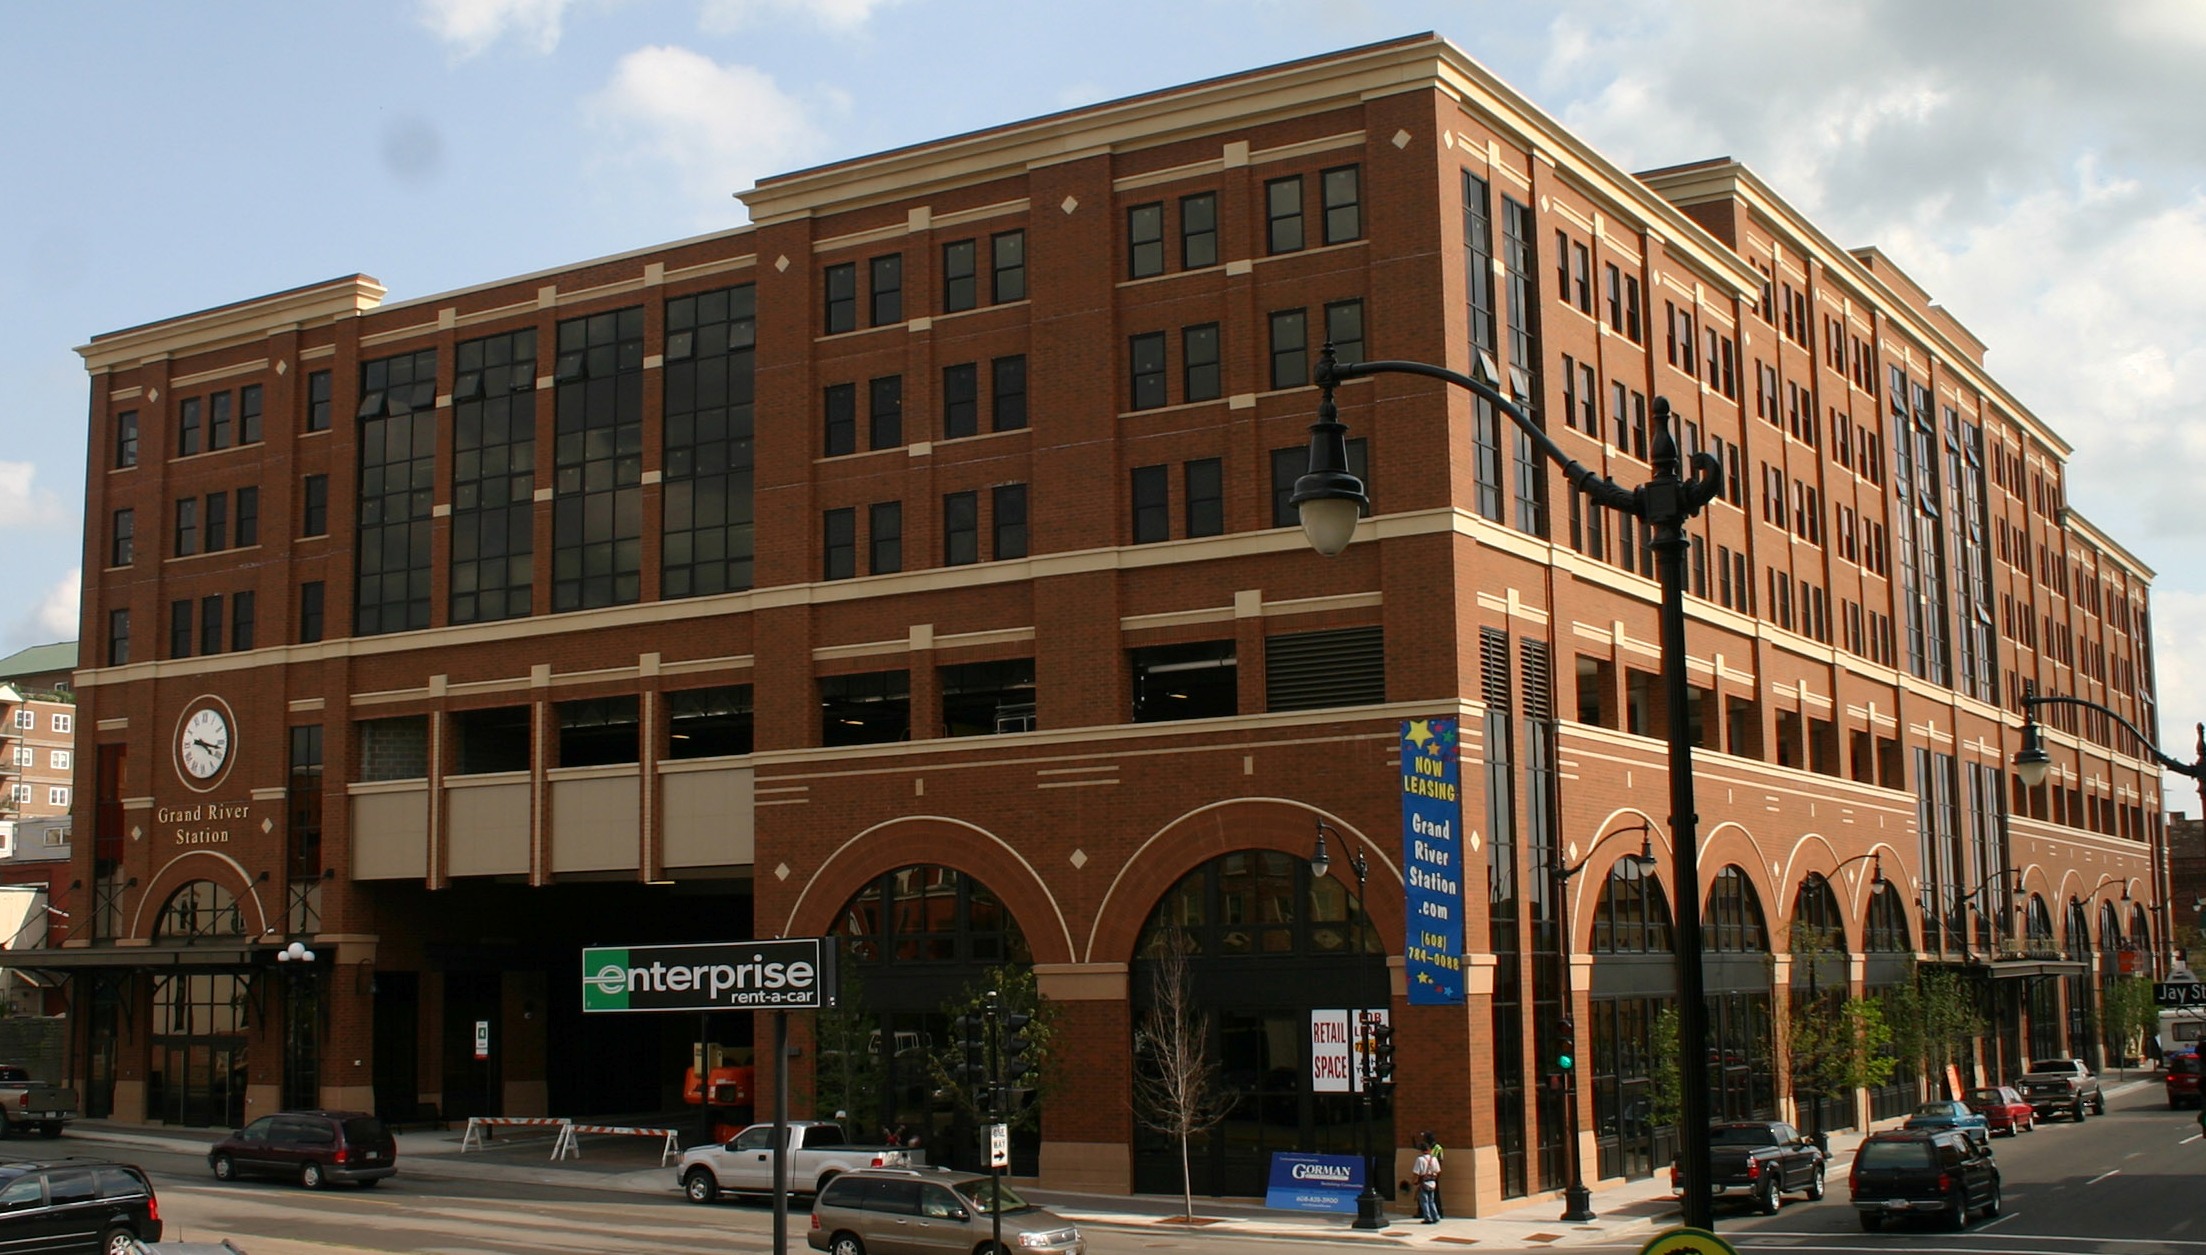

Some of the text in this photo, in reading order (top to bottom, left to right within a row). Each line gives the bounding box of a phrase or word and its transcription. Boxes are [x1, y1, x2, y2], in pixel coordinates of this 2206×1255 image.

[1415, 756, 1443, 778] NOW
[1404, 775, 1456, 802] LEASING
[158, 803, 249, 823] Grand River
[176, 827, 229, 845] Station
[1412, 812, 1450, 840] Grand
[1414, 840, 1449, 866] River
[1409, 866, 1457, 895] Station
[1418, 901, 1448, 920] .com
[1421, 929, 1447, 953] (608)
[1408, 946, 1460, 972] 784-0088
[597, 954, 814, 999] enterprise
[731, 990, 814, 1004] rent-a-car
[2158, 984, 2187, 1004] Jay
[1313, 1022, 1347, 1044] RETAIL
[1314, 1055, 1348, 1079] SPACE
[1292, 1163, 1351, 1180] GORMAN
